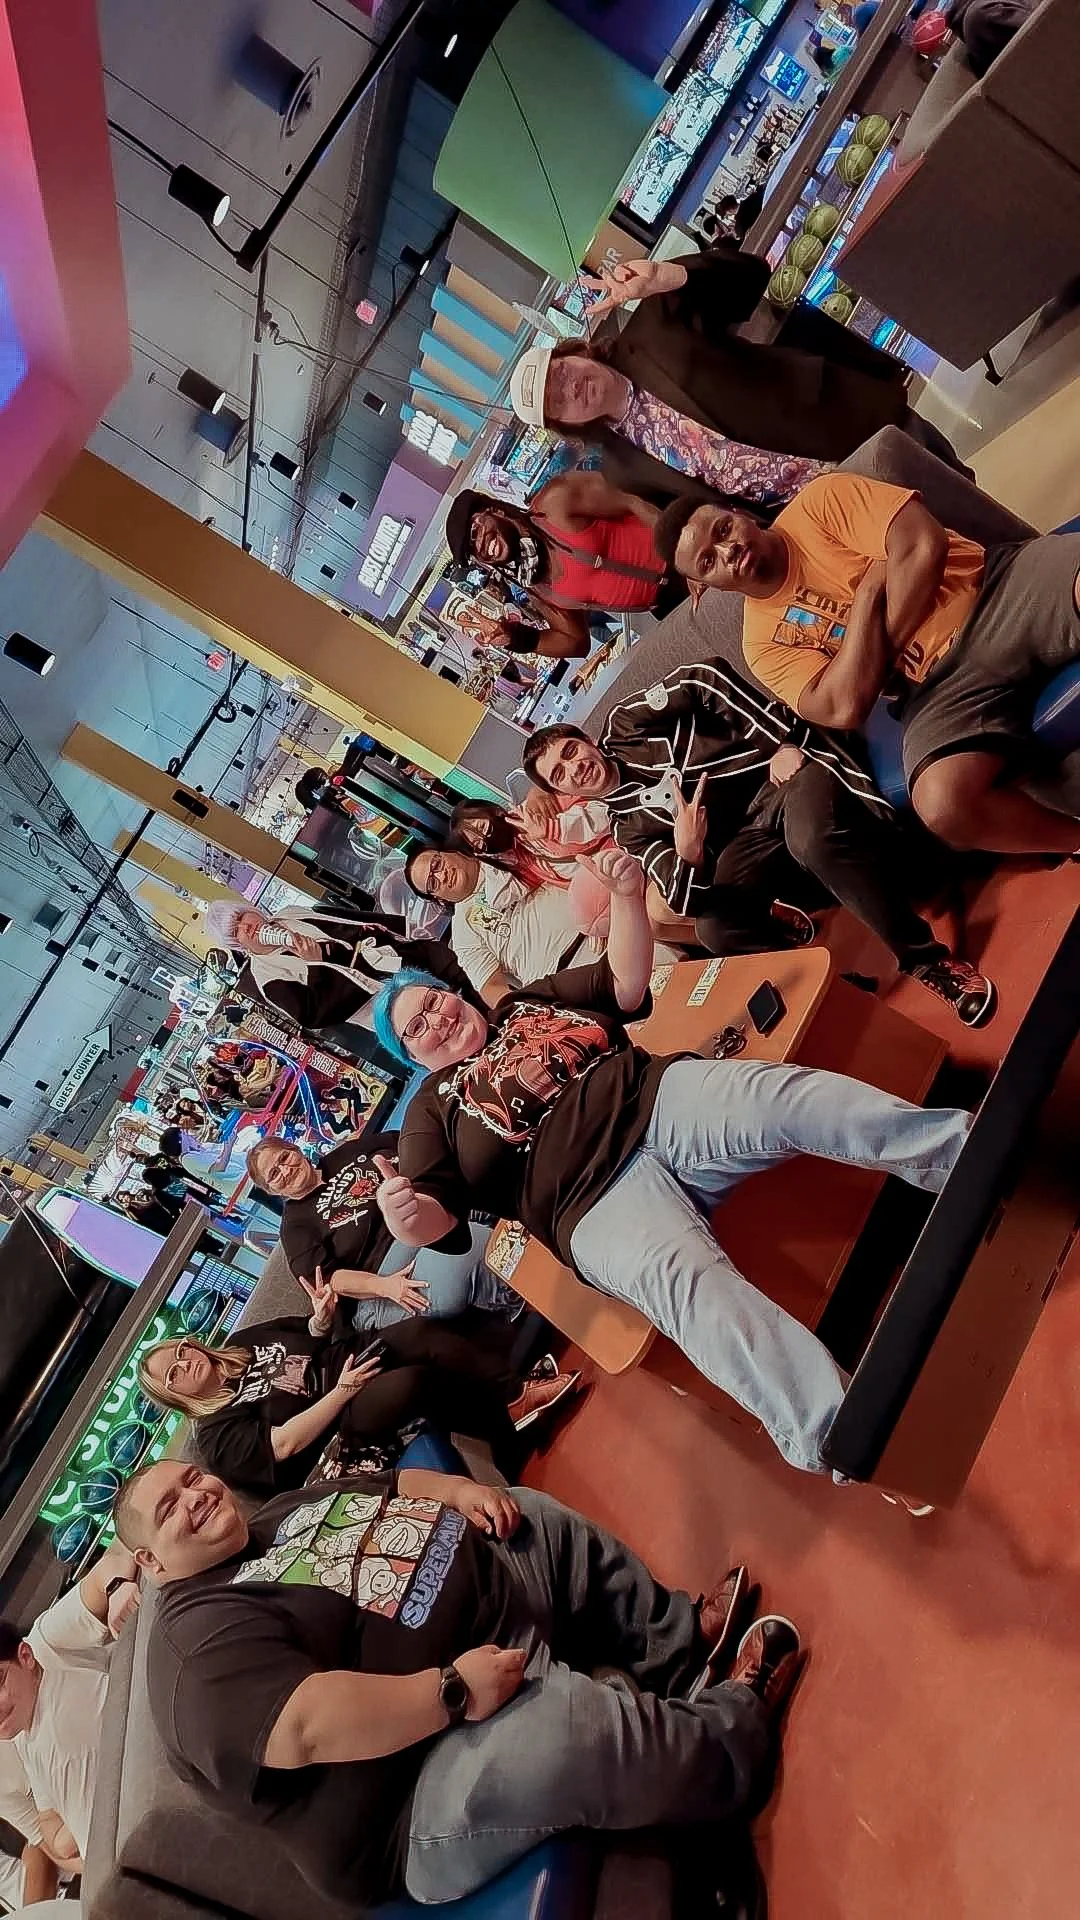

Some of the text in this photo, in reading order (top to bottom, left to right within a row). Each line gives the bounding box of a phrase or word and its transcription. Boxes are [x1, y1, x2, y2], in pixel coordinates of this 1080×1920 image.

[368, 515, 403, 563] COUNTER
[358, 555, 384, 590] GUEST
[55, 1043, 101, 1108] GUEST COUNTER
[333, 1172, 355, 1201] CLUB
[400, 1542, 456, 1630] SUPER
